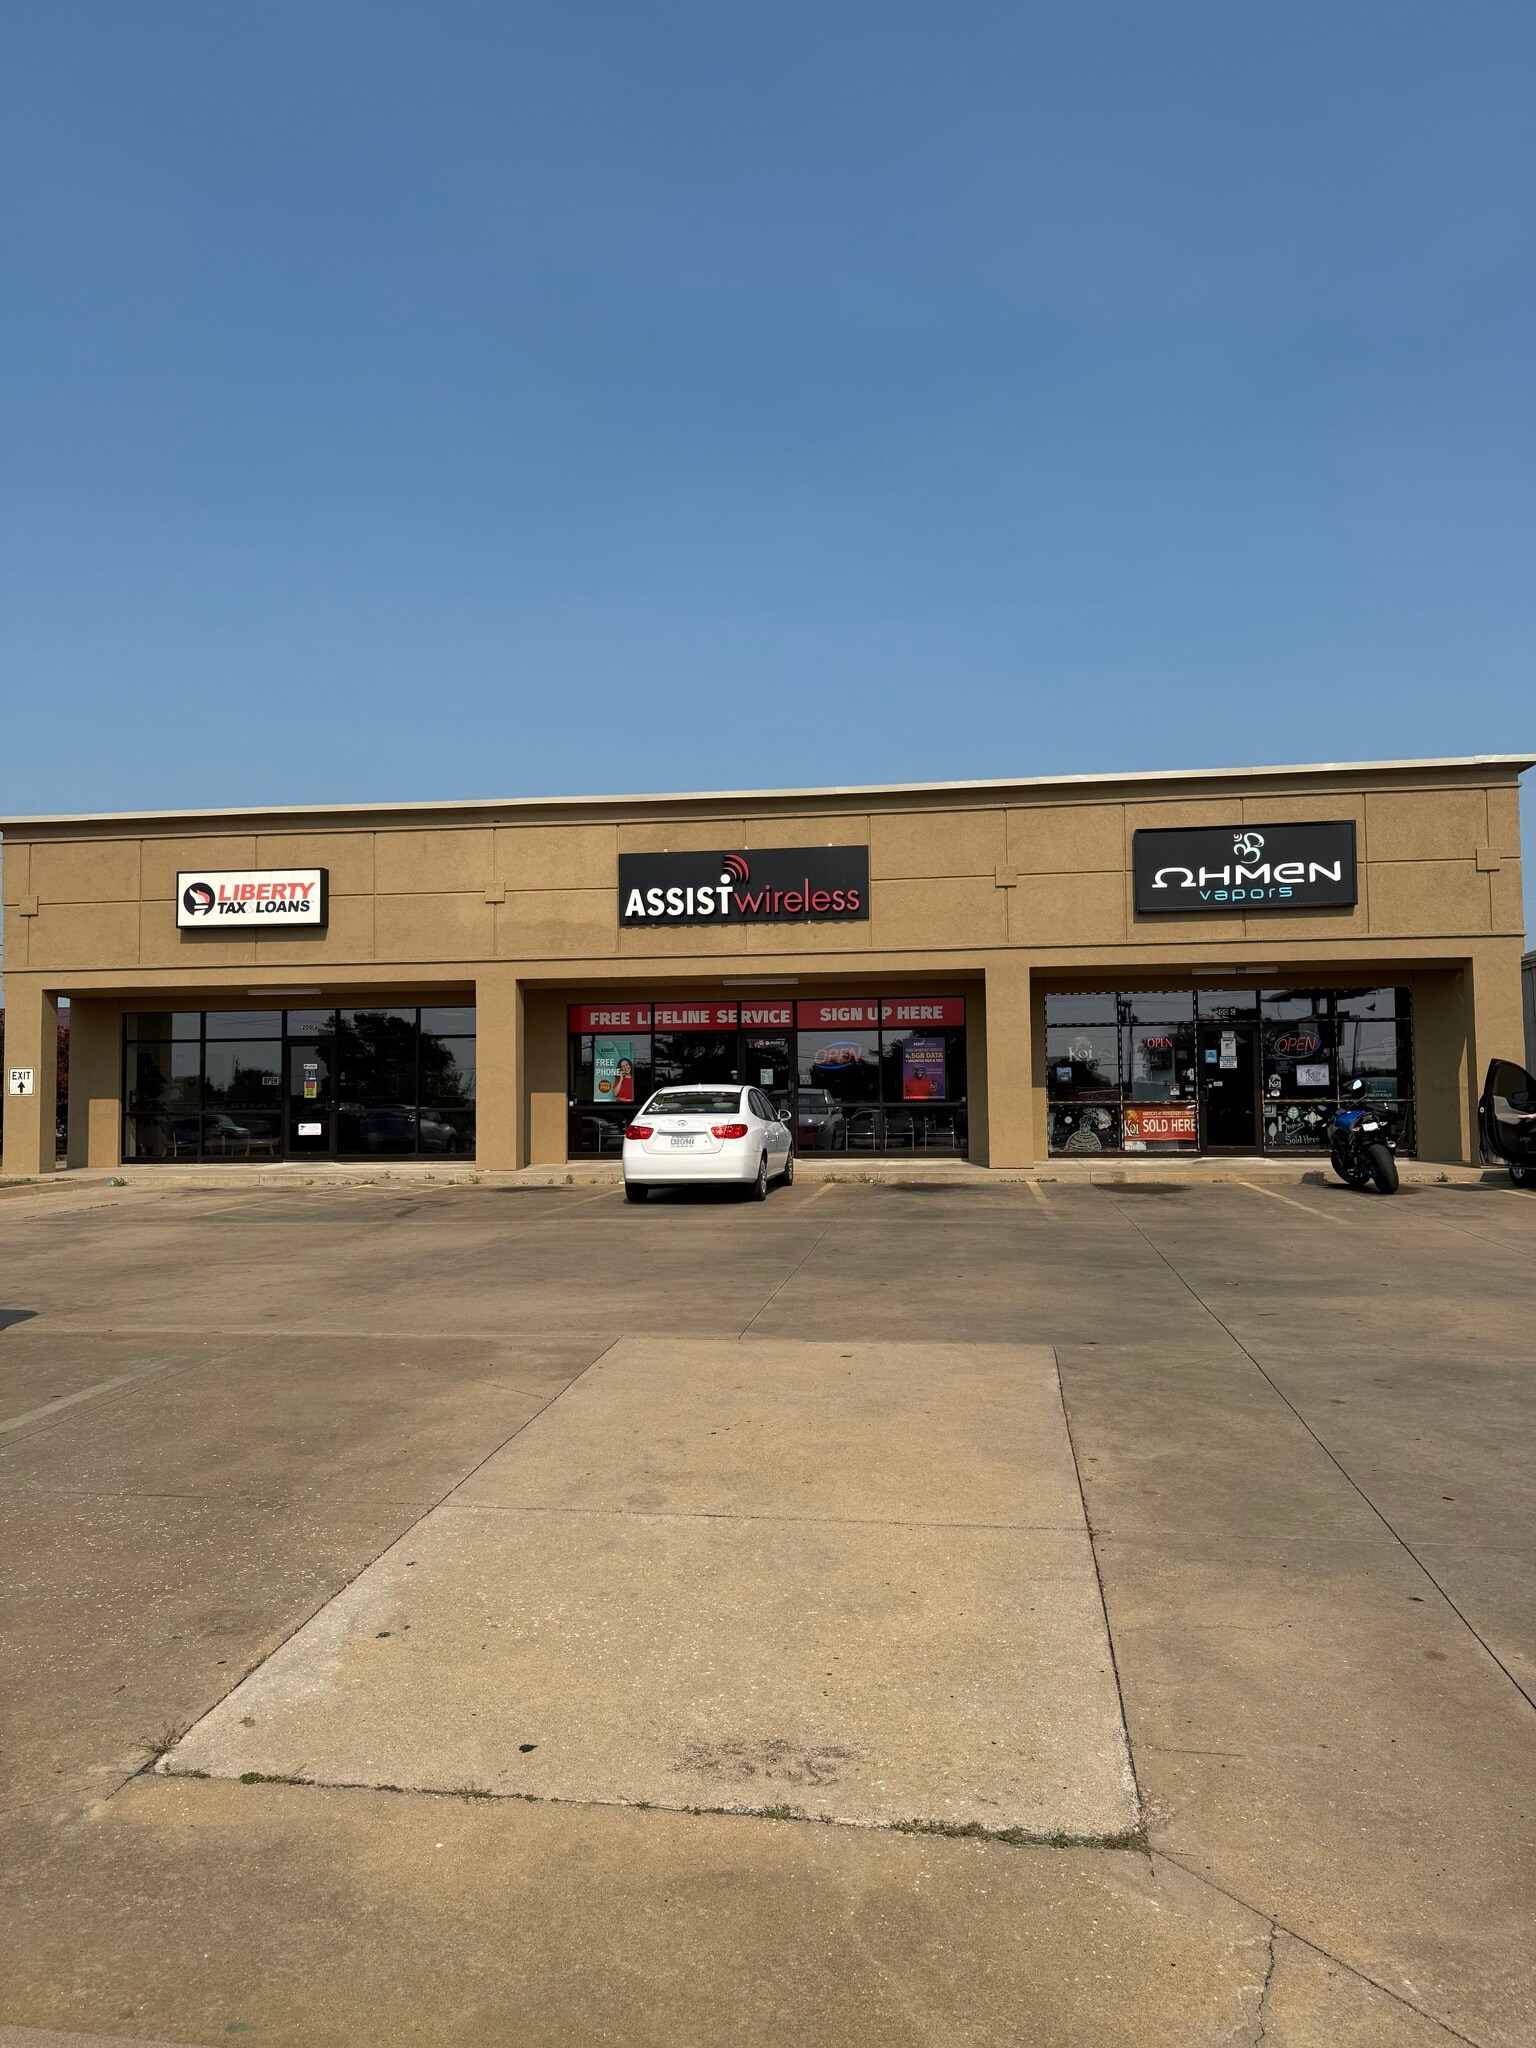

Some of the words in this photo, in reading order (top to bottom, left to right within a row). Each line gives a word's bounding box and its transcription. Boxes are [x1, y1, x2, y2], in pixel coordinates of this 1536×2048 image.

[218, 883, 315, 901] LIBERTY
[625, 873, 733, 917] ASSIST
[733, 877, 861, 914] wireless
[1199, 886, 1293, 902] vapors
[217, 901, 247, 914] TAX
[255, 900, 311, 913] LOANS
[590, 1012, 631, 1026] FREE
[637, 1010, 710, 1025] LIFELINE
[716, 1009, 791, 1024] SERVICE
[820, 1006, 863, 1022] SIGN
[867, 1006, 893, 1021] UP
[897, 1005, 944, 1020] HERE
[1147, 1037, 1173, 1048] OPEN
[1277, 1037, 1316, 1051] OPEN
[813, 1047, 862, 1064] OPEN
[1068, 1045, 1093, 1062] Koi
[596, 1058, 615, 1067] FREE
[12, 1071, 31, 1080] EXIT
[596, 1068, 621, 1076] PHONE
[1124, 1119, 1140, 1137] Koi
[1143, 1119, 1169, 1133] SOLD
[1171, 1118, 1197, 1132] HERE
[1285, 1135, 1303, 1145] Sold
[1303, 1134, 1321, 1144] Here
